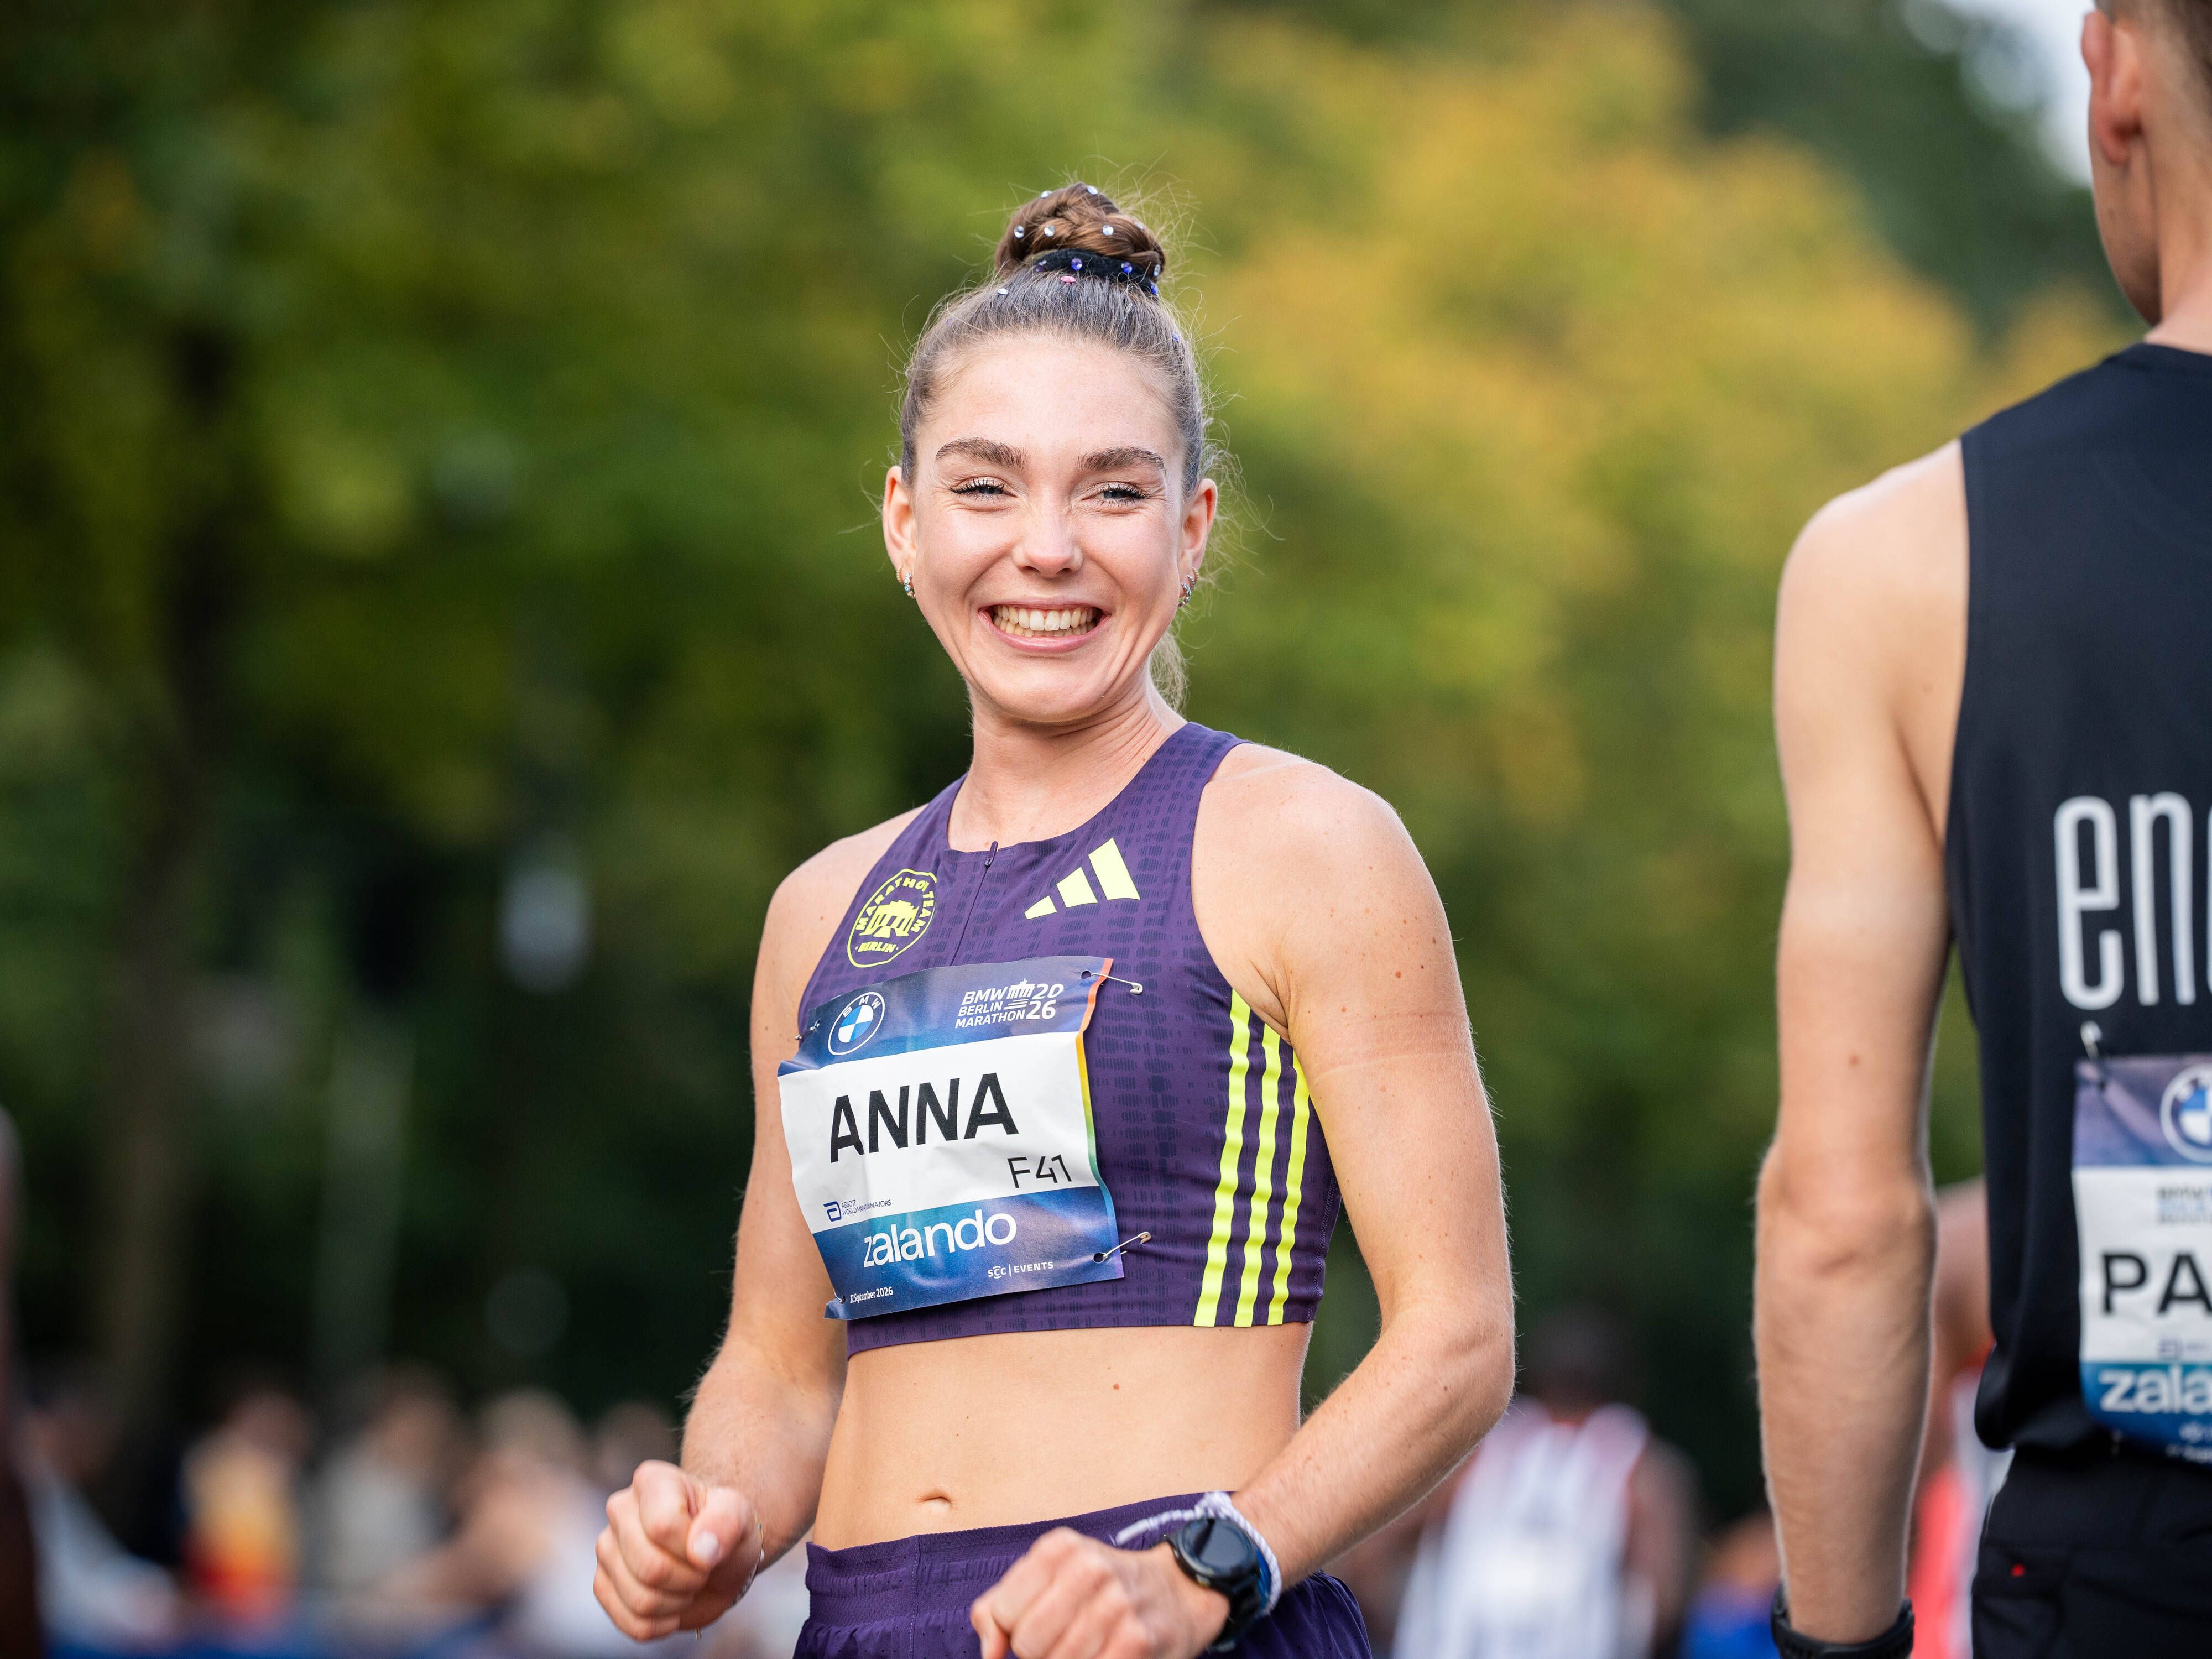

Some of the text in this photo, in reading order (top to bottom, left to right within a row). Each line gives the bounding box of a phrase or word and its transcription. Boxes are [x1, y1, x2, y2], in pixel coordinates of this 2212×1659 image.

[2053, 791, 2212, 1010] en
[910, 891, 935, 932] TEAM
[858, 941, 897, 953] BERLIN
[961, 986, 1009, 1005] BMW
[1031, 983, 1065, 1000] 20
[843, 995, 881, 1018] BMW
[958, 1001, 1003, 1017] BERLIN
[1026, 1000, 1057, 1020] 26
[955, 1009, 1025, 1029] MARATHON
[830, 1072, 1019, 1163] ANNA
[1007, 1154, 1072, 1188] F41
[841, 1199, 856, 1209] ABBOTT
[842, 1207, 857, 1215] WORLD
[870, 1199, 891, 1209] MAJORS
[863, 1209, 1017, 1268] zalando
[987, 1261, 1054, 1279] SCC EVENTS
[2102, 1252, 2212, 1315] PA
[854, 1291, 875, 1303] September
[876, 1286, 894, 1297] 2026
